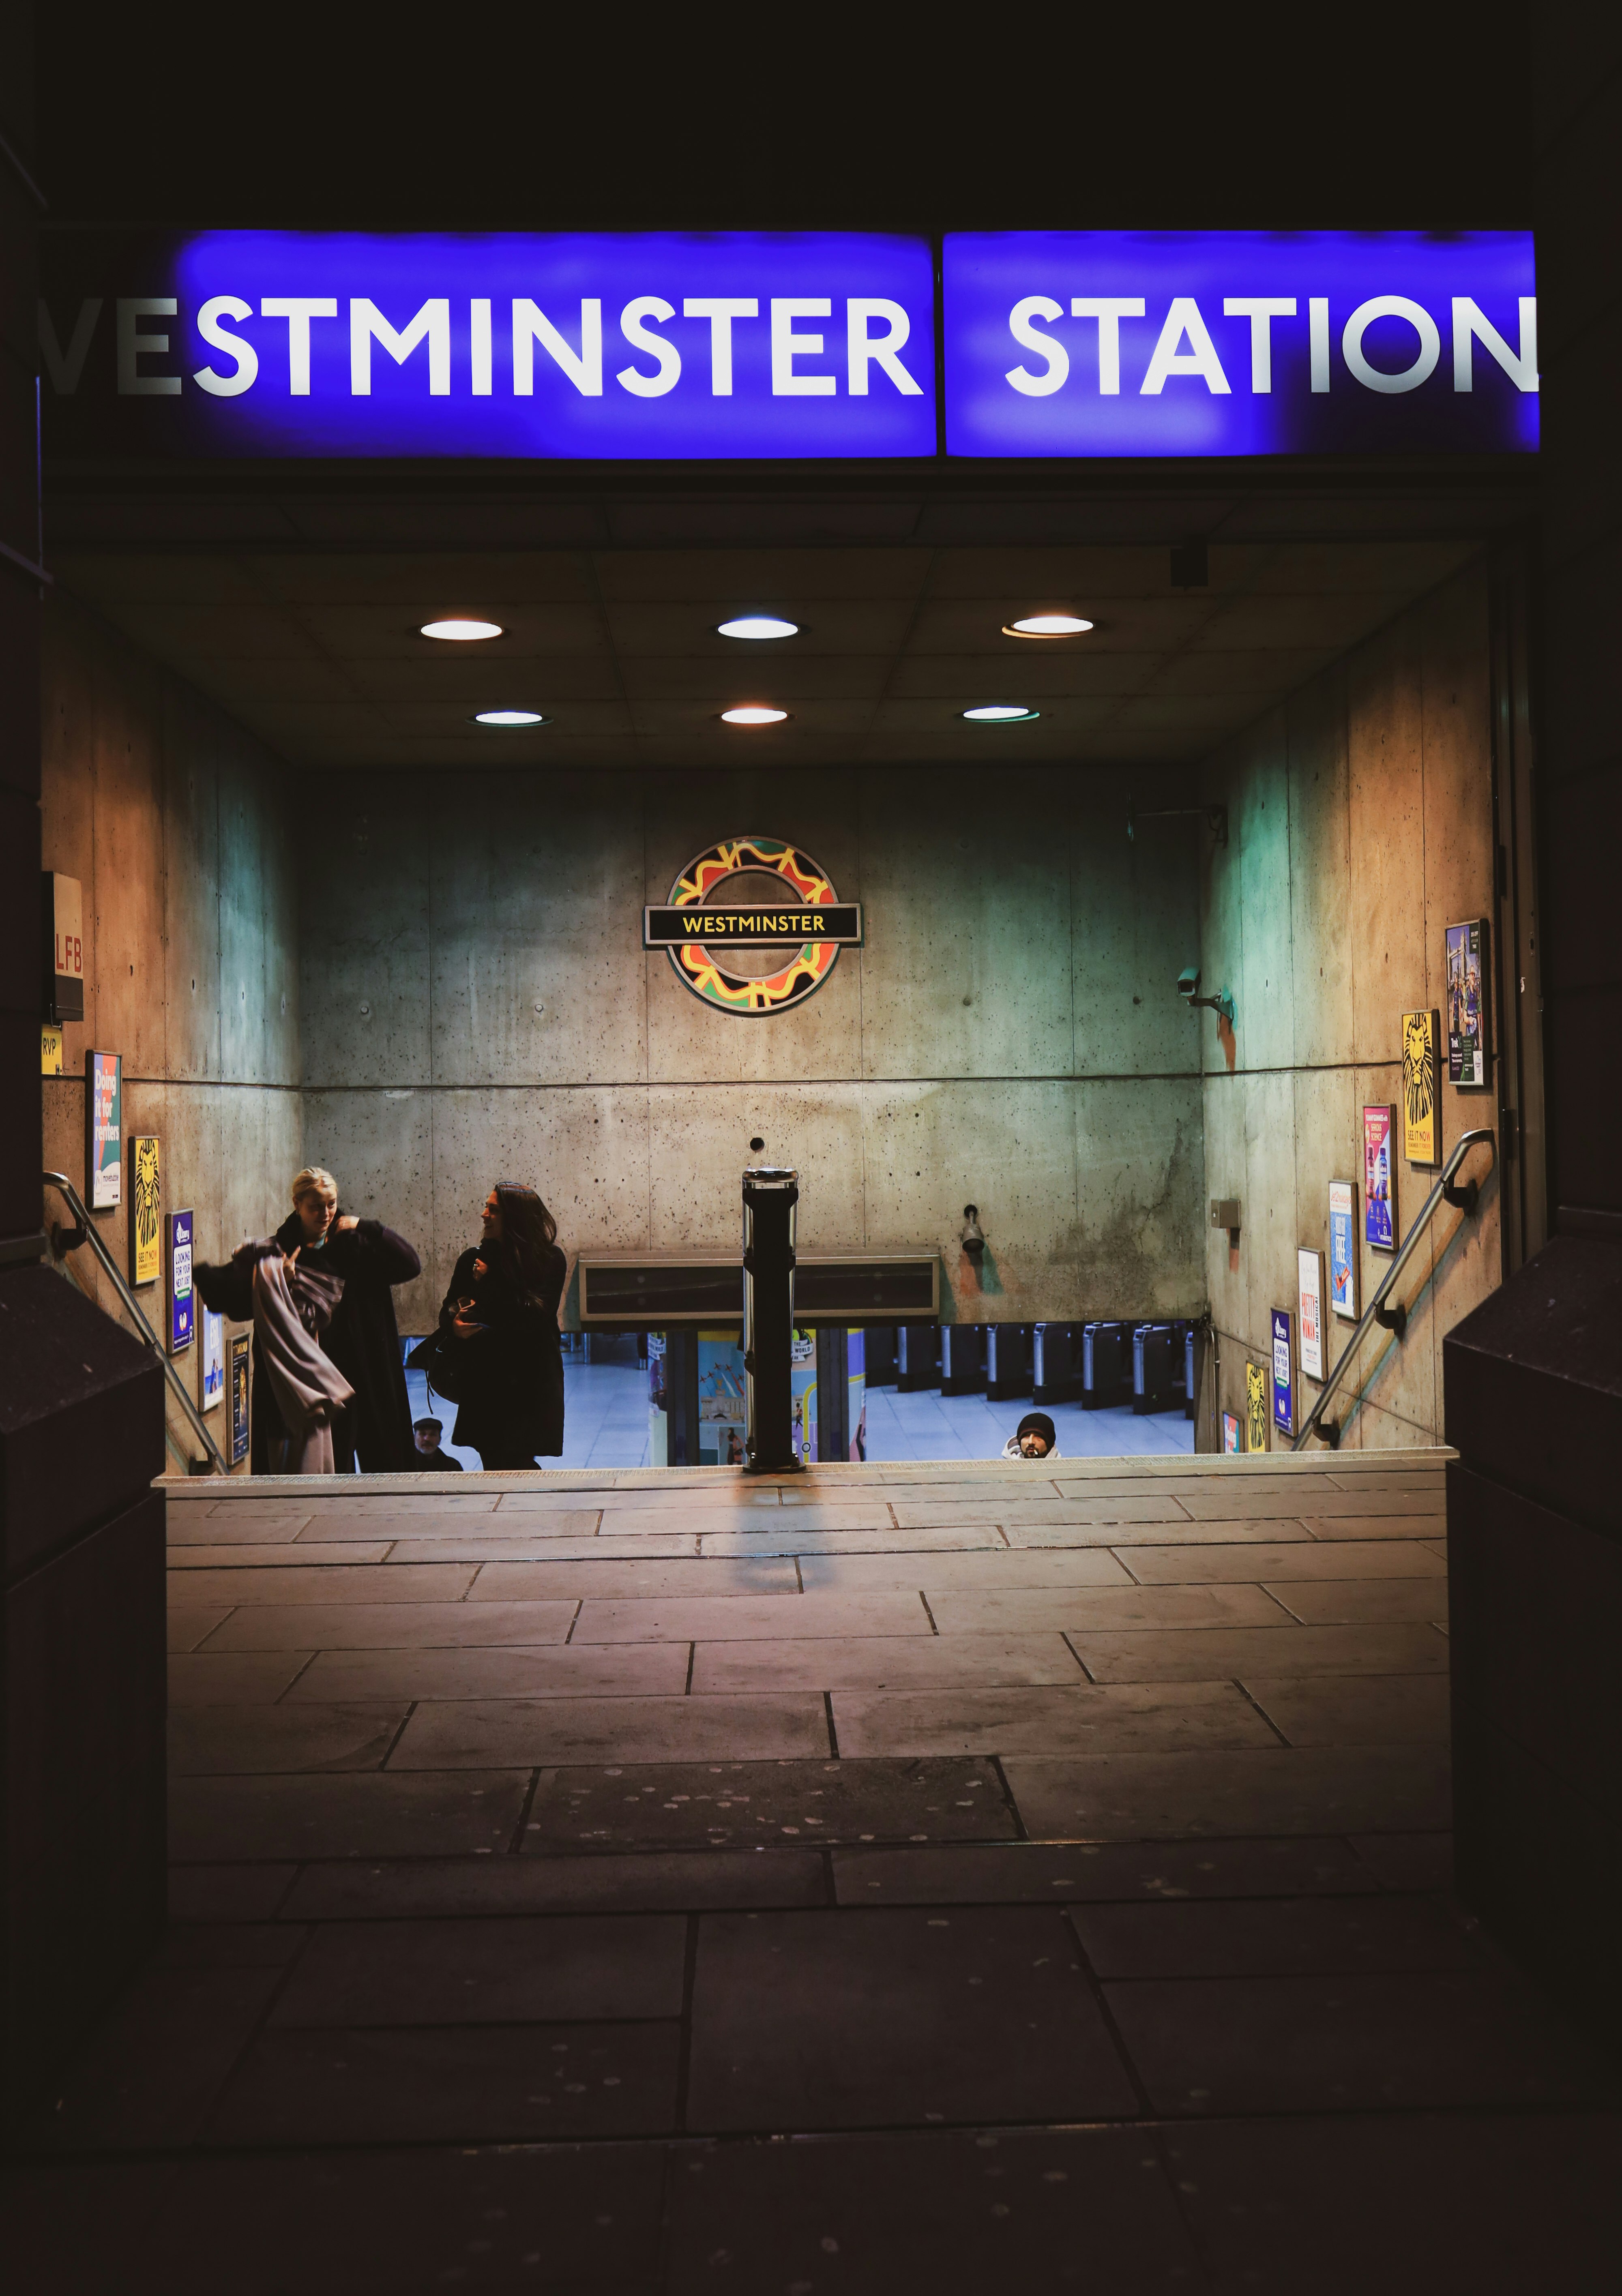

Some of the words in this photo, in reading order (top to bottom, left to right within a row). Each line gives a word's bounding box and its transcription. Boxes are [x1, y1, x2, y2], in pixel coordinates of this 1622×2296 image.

[1005, 296, 1539, 397] STATION
[683, 915, 825, 933] WESTMINSTER
[56, 933, 82, 973] LFB
[43, 1038, 56, 1056] RVP
[95, 1068, 116, 1096] Doing
[95, 1095, 101, 1118] it
[102, 1096, 113, 1118] for
[95, 1122, 119, 1141] renters
[1371, 1133, 1382, 1141] SCIENCE
[1415, 1130, 1418, 1140] IT
[1420, 1131, 1430, 1142] NOW
[145, 1251, 148, 1261] IT
[149, 1250, 157, 1260] NOW
[176, 1251, 190, 1264] LOOKING
[1336, 1235, 1346, 1264] FREE
[1302, 1292, 1315, 1318] PRETTY
[1275, 1345, 1287, 1357] LOOKING
[1225, 1424, 1236, 1448] Doing
